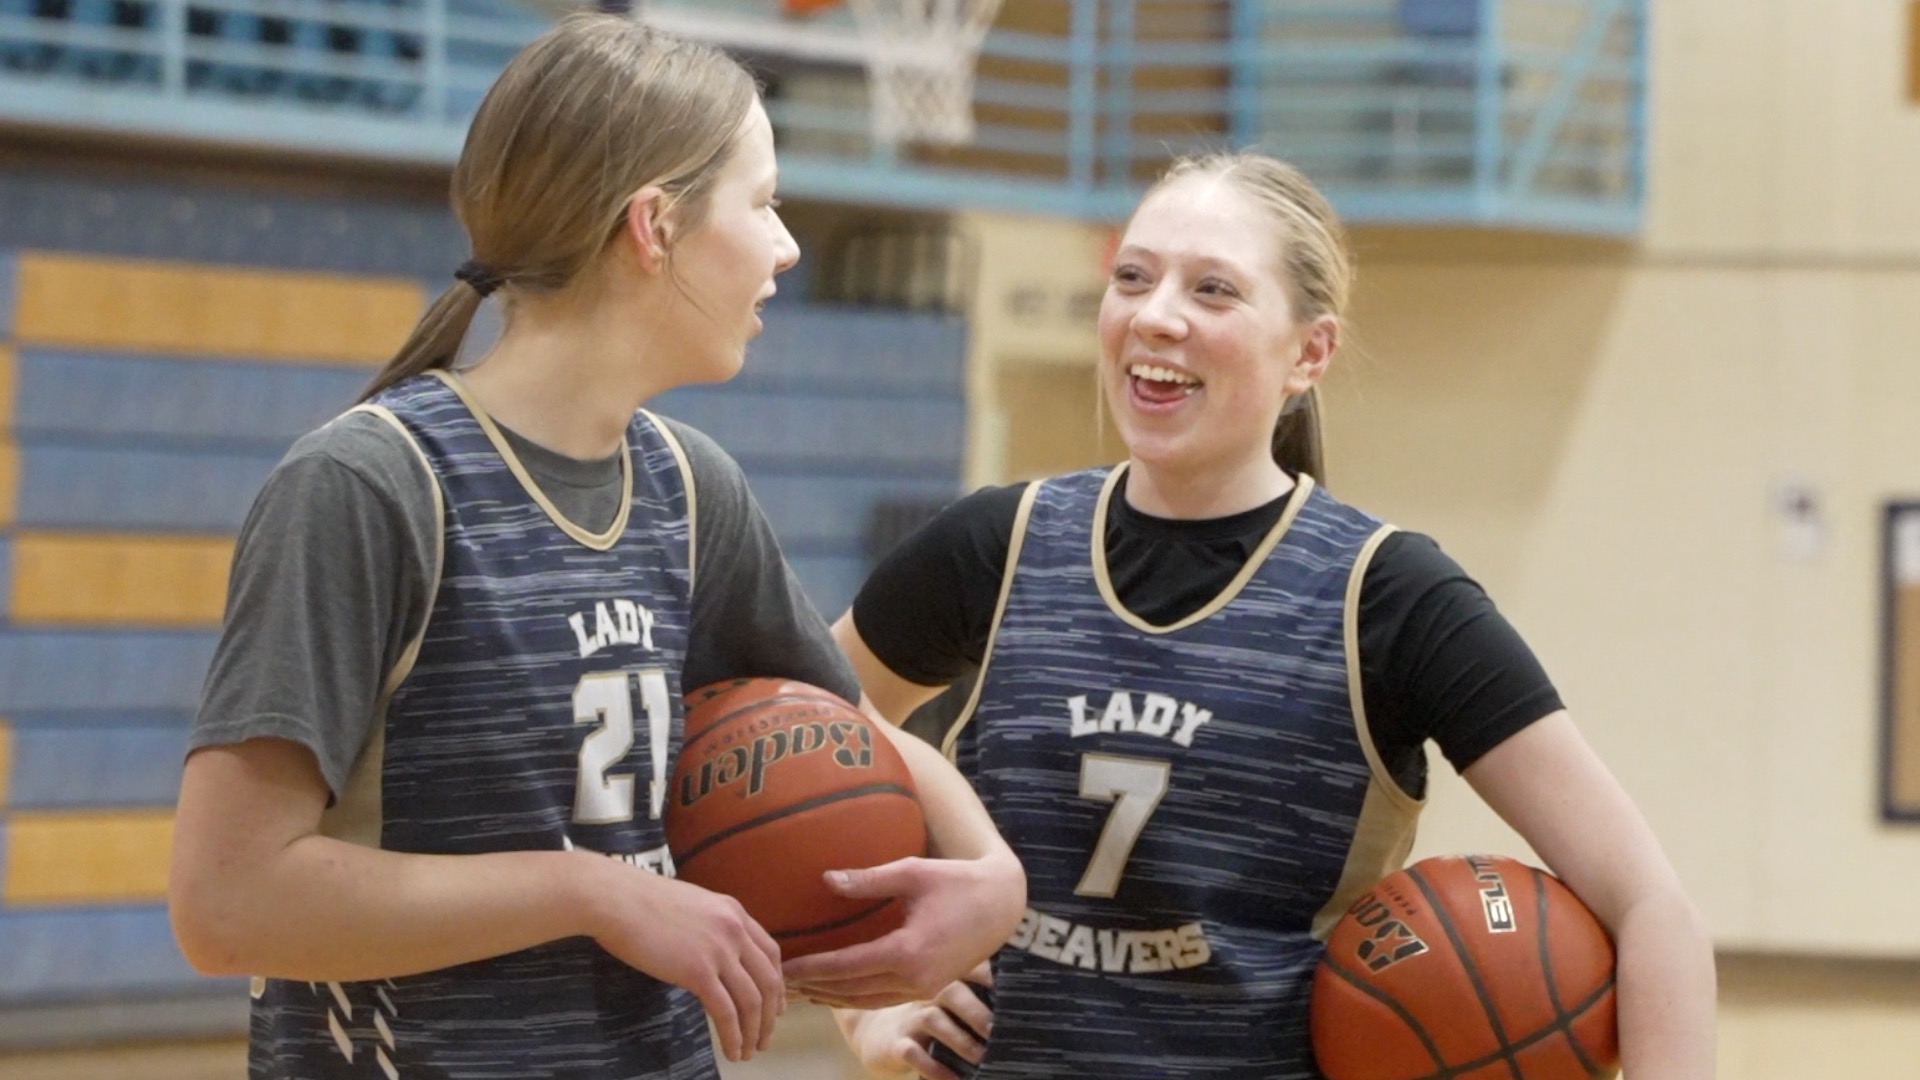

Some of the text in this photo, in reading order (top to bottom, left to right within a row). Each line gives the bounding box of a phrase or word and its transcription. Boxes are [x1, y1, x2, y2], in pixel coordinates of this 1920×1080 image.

[569, 600, 655, 658] LADY
[572, 669, 671, 824] 21
[1068, 691, 1213, 747] LADY
[682, 721, 874, 806] Baden
[1073, 753, 1172, 899] 7
[1005, 907, 1212, 973] BEAVERS
